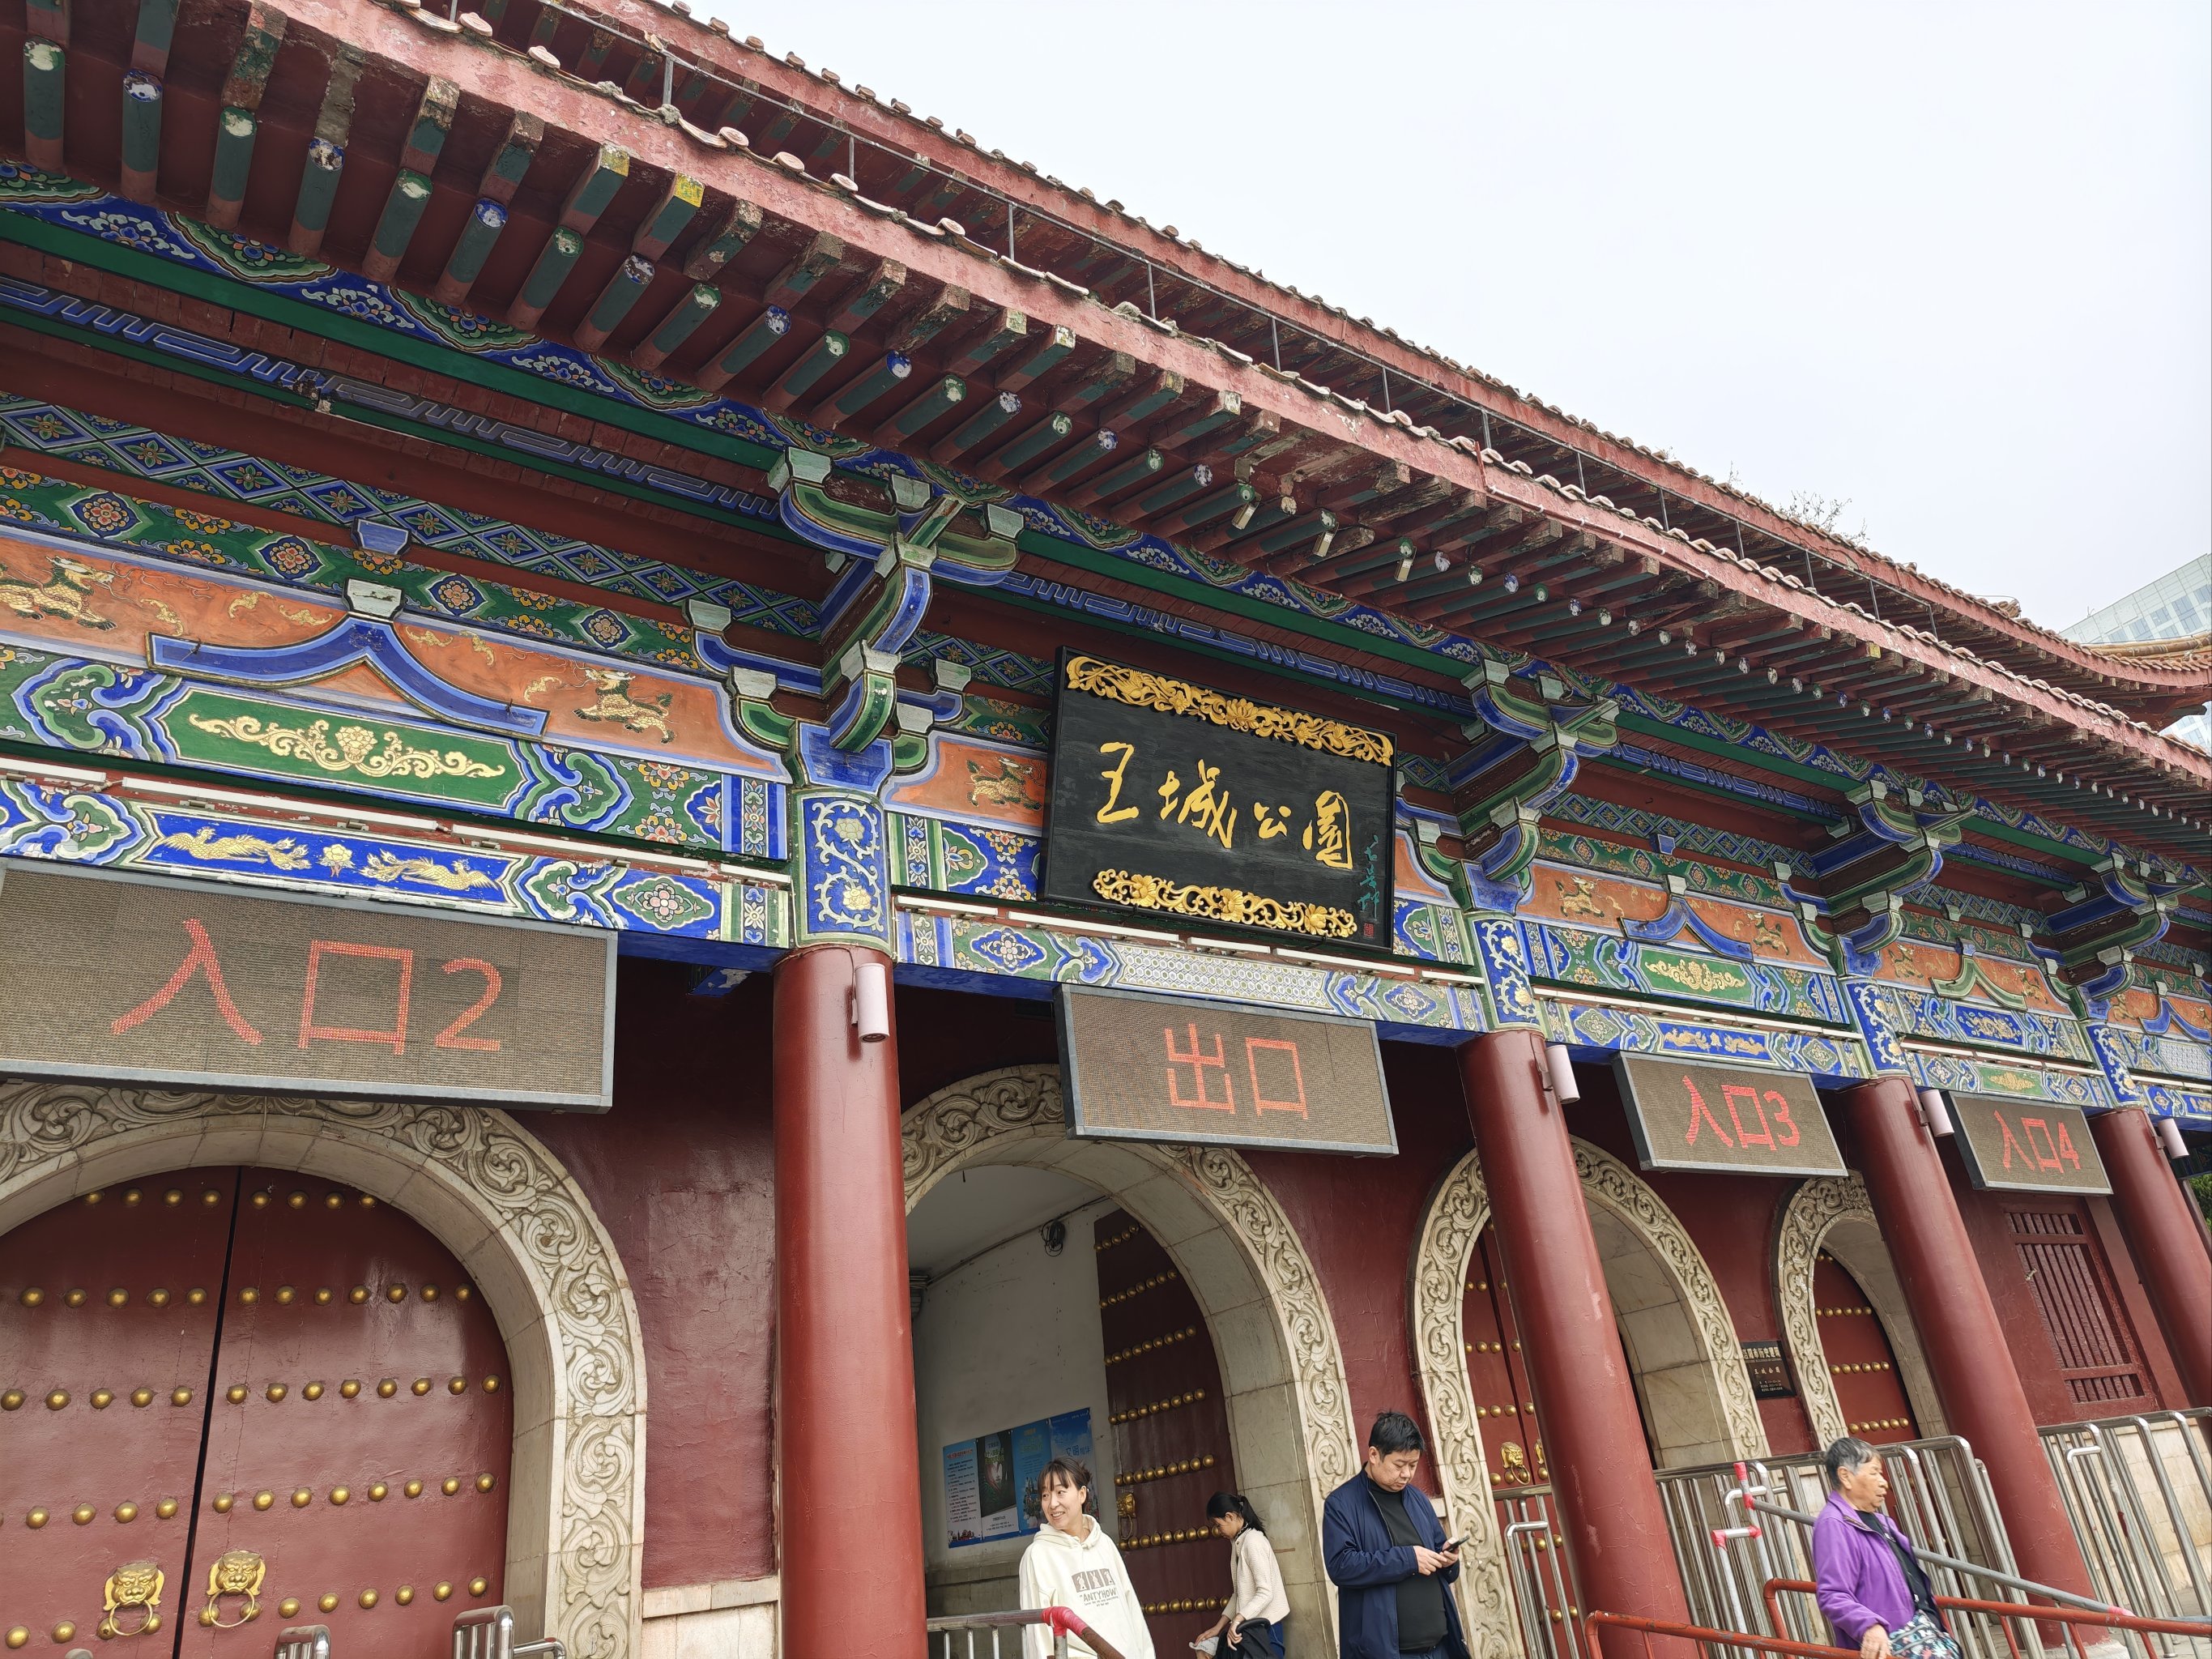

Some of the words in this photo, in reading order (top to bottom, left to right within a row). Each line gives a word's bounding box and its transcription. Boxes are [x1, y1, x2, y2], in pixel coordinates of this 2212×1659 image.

[110, 917, 503, 1056] 入口2
[1164, 1022, 1308, 1120] 出口
[1681, 1074, 1801, 1151] 入口3
[1993, 1110, 2081, 1174] 入口4
